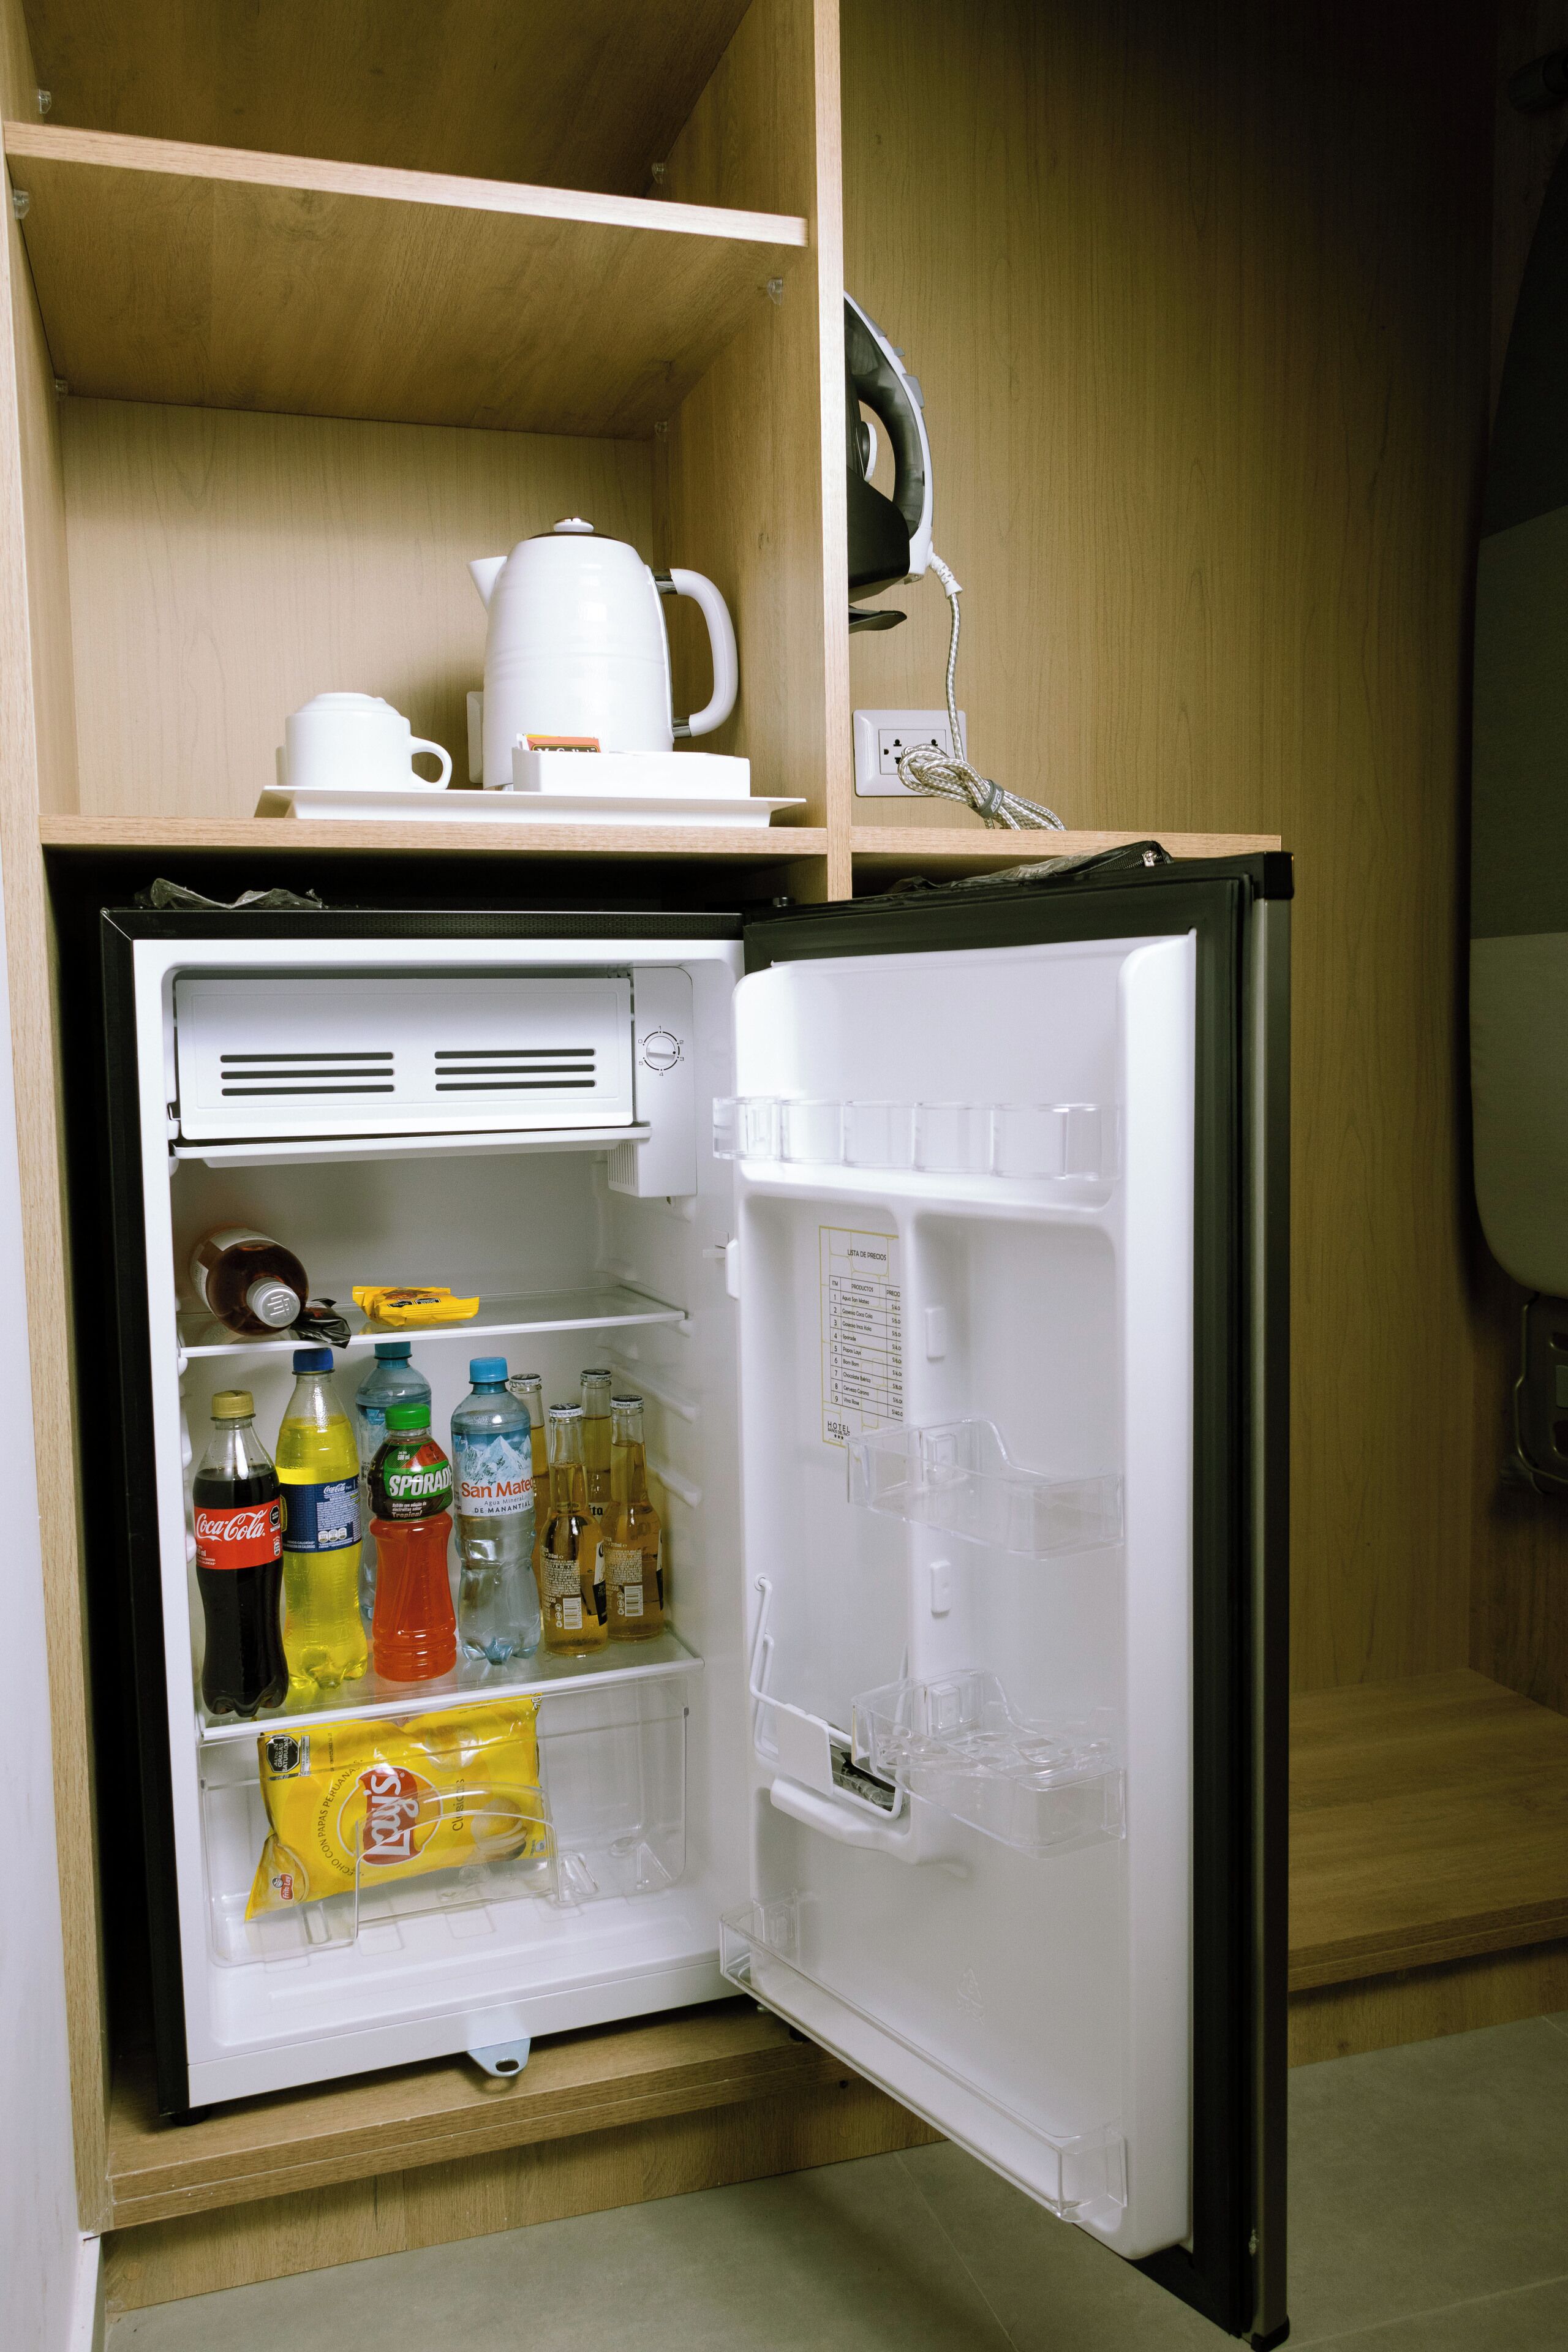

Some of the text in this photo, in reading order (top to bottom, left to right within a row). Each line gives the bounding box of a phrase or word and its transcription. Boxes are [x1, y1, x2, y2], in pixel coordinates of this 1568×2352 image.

[867, 1252, 886, 1261] PRECIOS
[843, 1371, 859, 1381] Chocolate
[827, 1421, 850, 1433] HOTEL
[389, 1465, 452, 1496] SPORADE
[461, 1482, 492, 1498] San
[392, 1509, 423, 1518] Tropical
[488, 1501, 530, 1513] MANANTIAL
[197, 1509, 268, 1542] Coca-Cola
[363, 1774, 419, 1855] Lay's
[318, 1810, 328, 1838] PAPAS
[320, 1839, 333, 1858] CON
